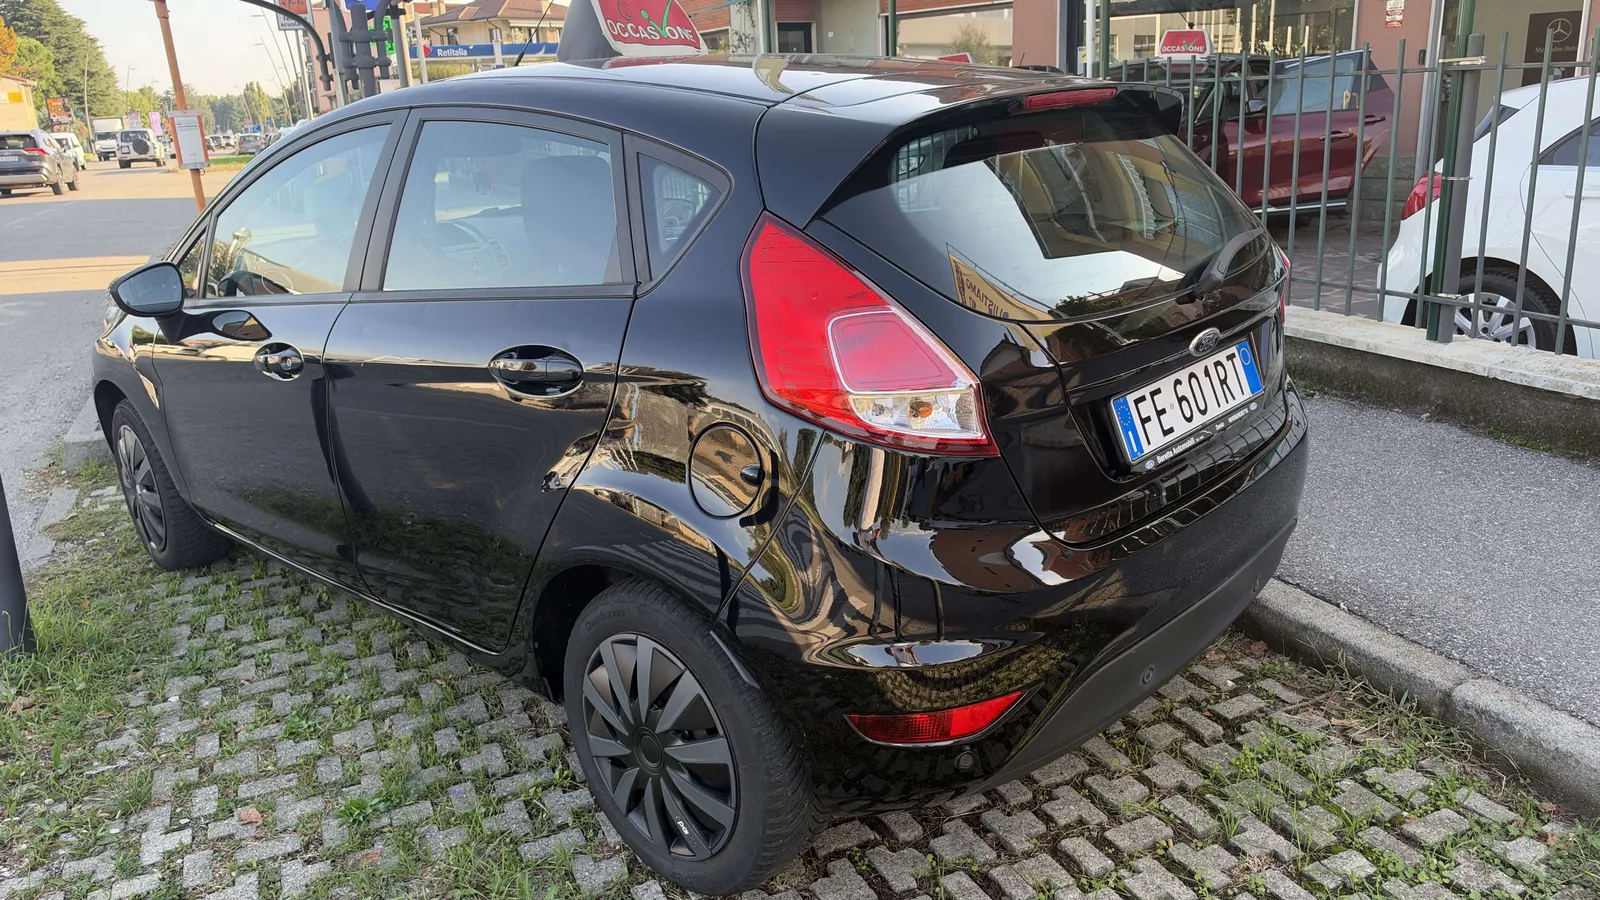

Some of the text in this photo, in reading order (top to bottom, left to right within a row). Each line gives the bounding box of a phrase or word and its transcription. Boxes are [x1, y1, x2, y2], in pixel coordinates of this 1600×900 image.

[437, 48, 468, 57] Retitalia
[1535, 45, 1563, 54] Medes
[1133, 352, 1245, 446] FE 601RT
